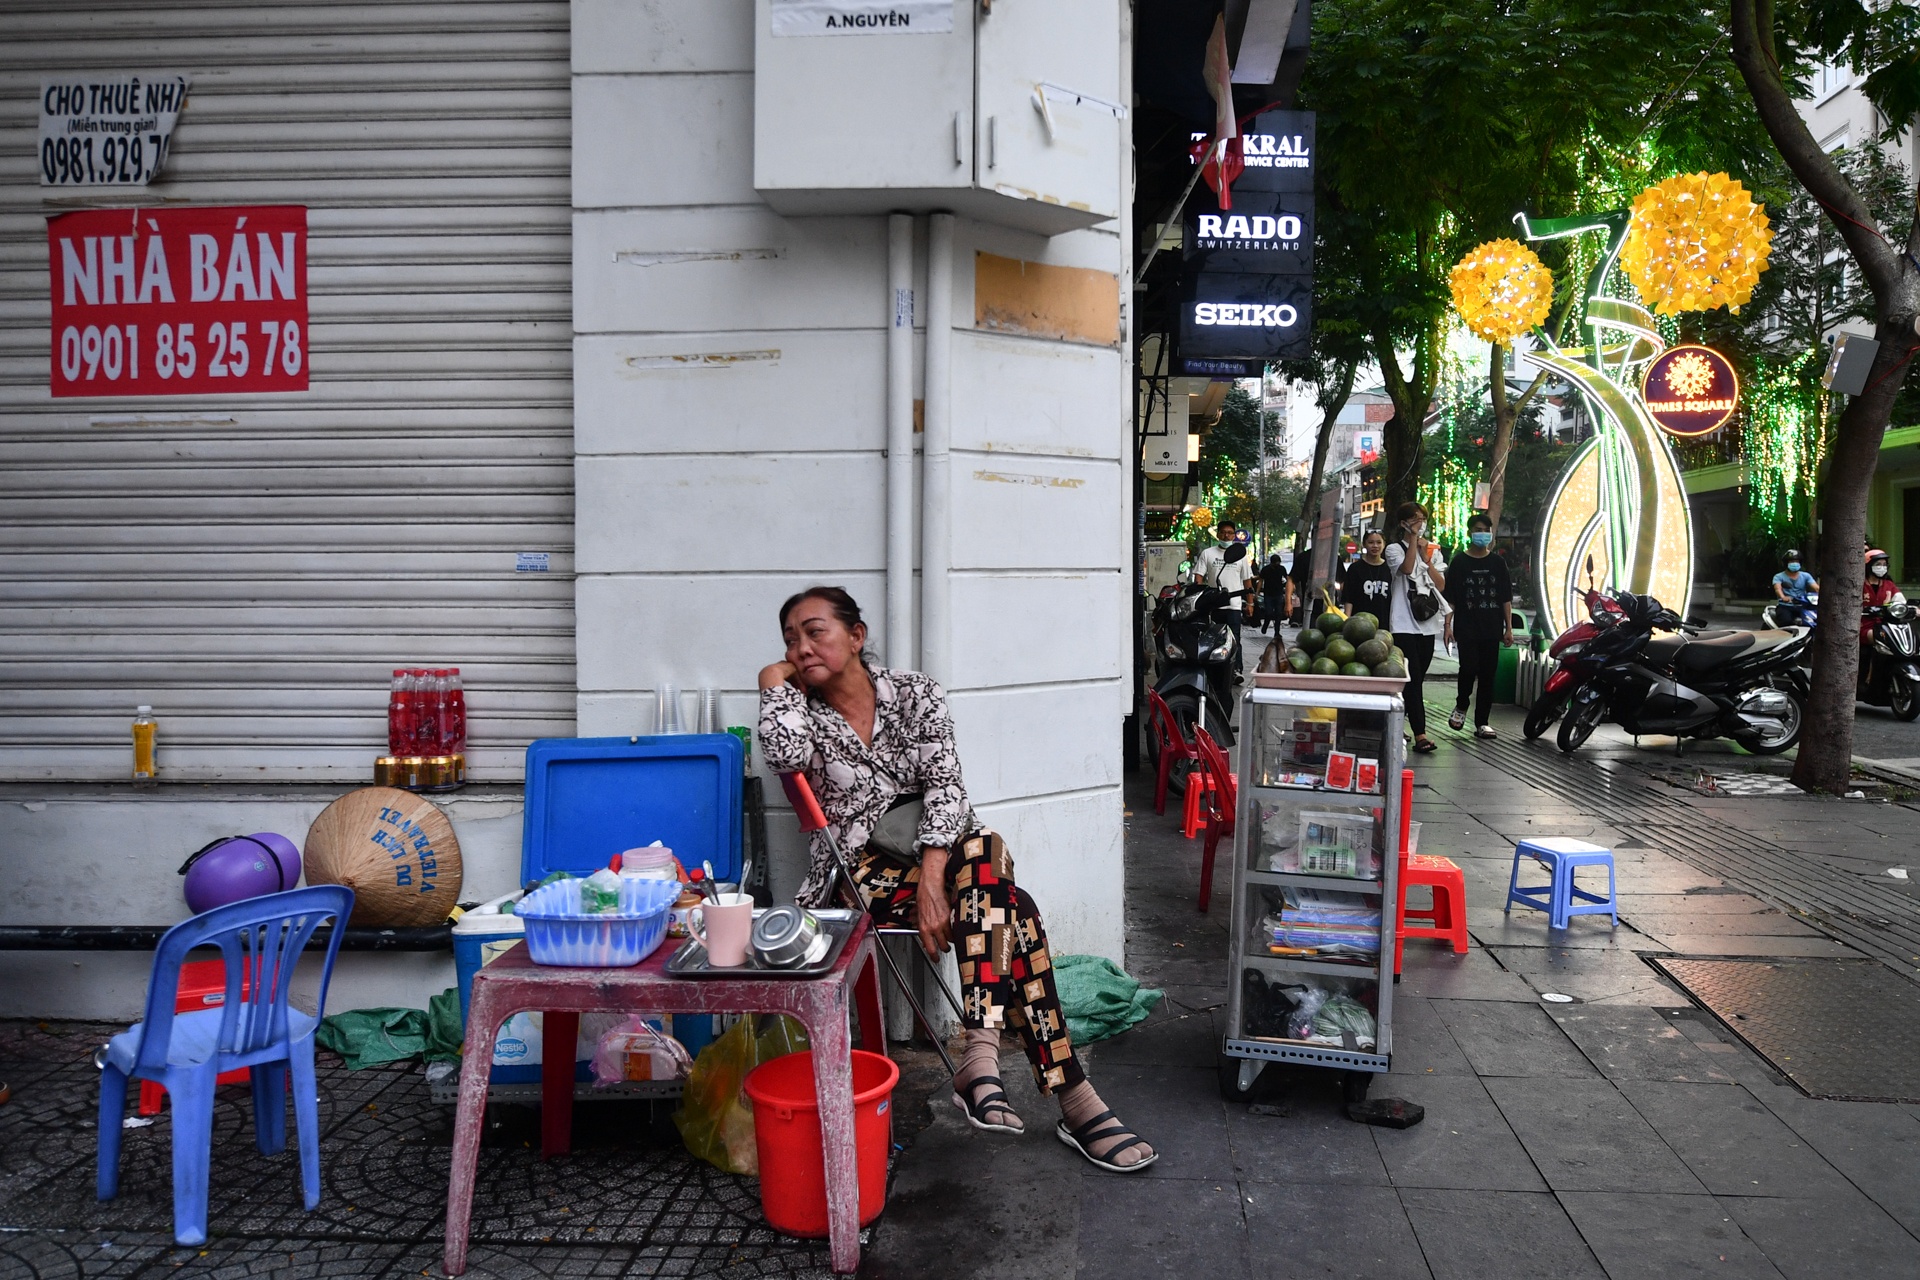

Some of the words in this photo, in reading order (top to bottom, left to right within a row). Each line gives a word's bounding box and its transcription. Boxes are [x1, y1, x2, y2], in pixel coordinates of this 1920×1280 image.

[826, 9, 910, 28] A.NGUYÊN
[44, 84, 85, 116] CHO
[89, 77, 140, 114] THUÊ
[100, 119, 131, 135] trung
[134, 116, 158, 135] gian)
[1275, 156, 1309, 168] CENTER
[1197, 215, 1301, 239] RADO
[1197, 240, 1300, 250] SWITZERLAND
[59, 218, 176, 306] NHÀ
[189, 216, 297, 303] BÁN
[1195, 303, 1297, 327] SEIKO
[61, 324, 139, 382] 0901
[155, 322, 197, 379] 85
[208, 321, 249, 378] 25
[261, 319, 301, 377] 78
[1220, 362, 1243, 370] Beauty
[1647, 402, 1683, 412] TIMES
[1684, 400, 1733, 412] SQUARE
[395, 864, 412, 886] DU
[1000, 927, 1011, 971] Michigan
[496, 1042, 525, 1053] Nestlé
